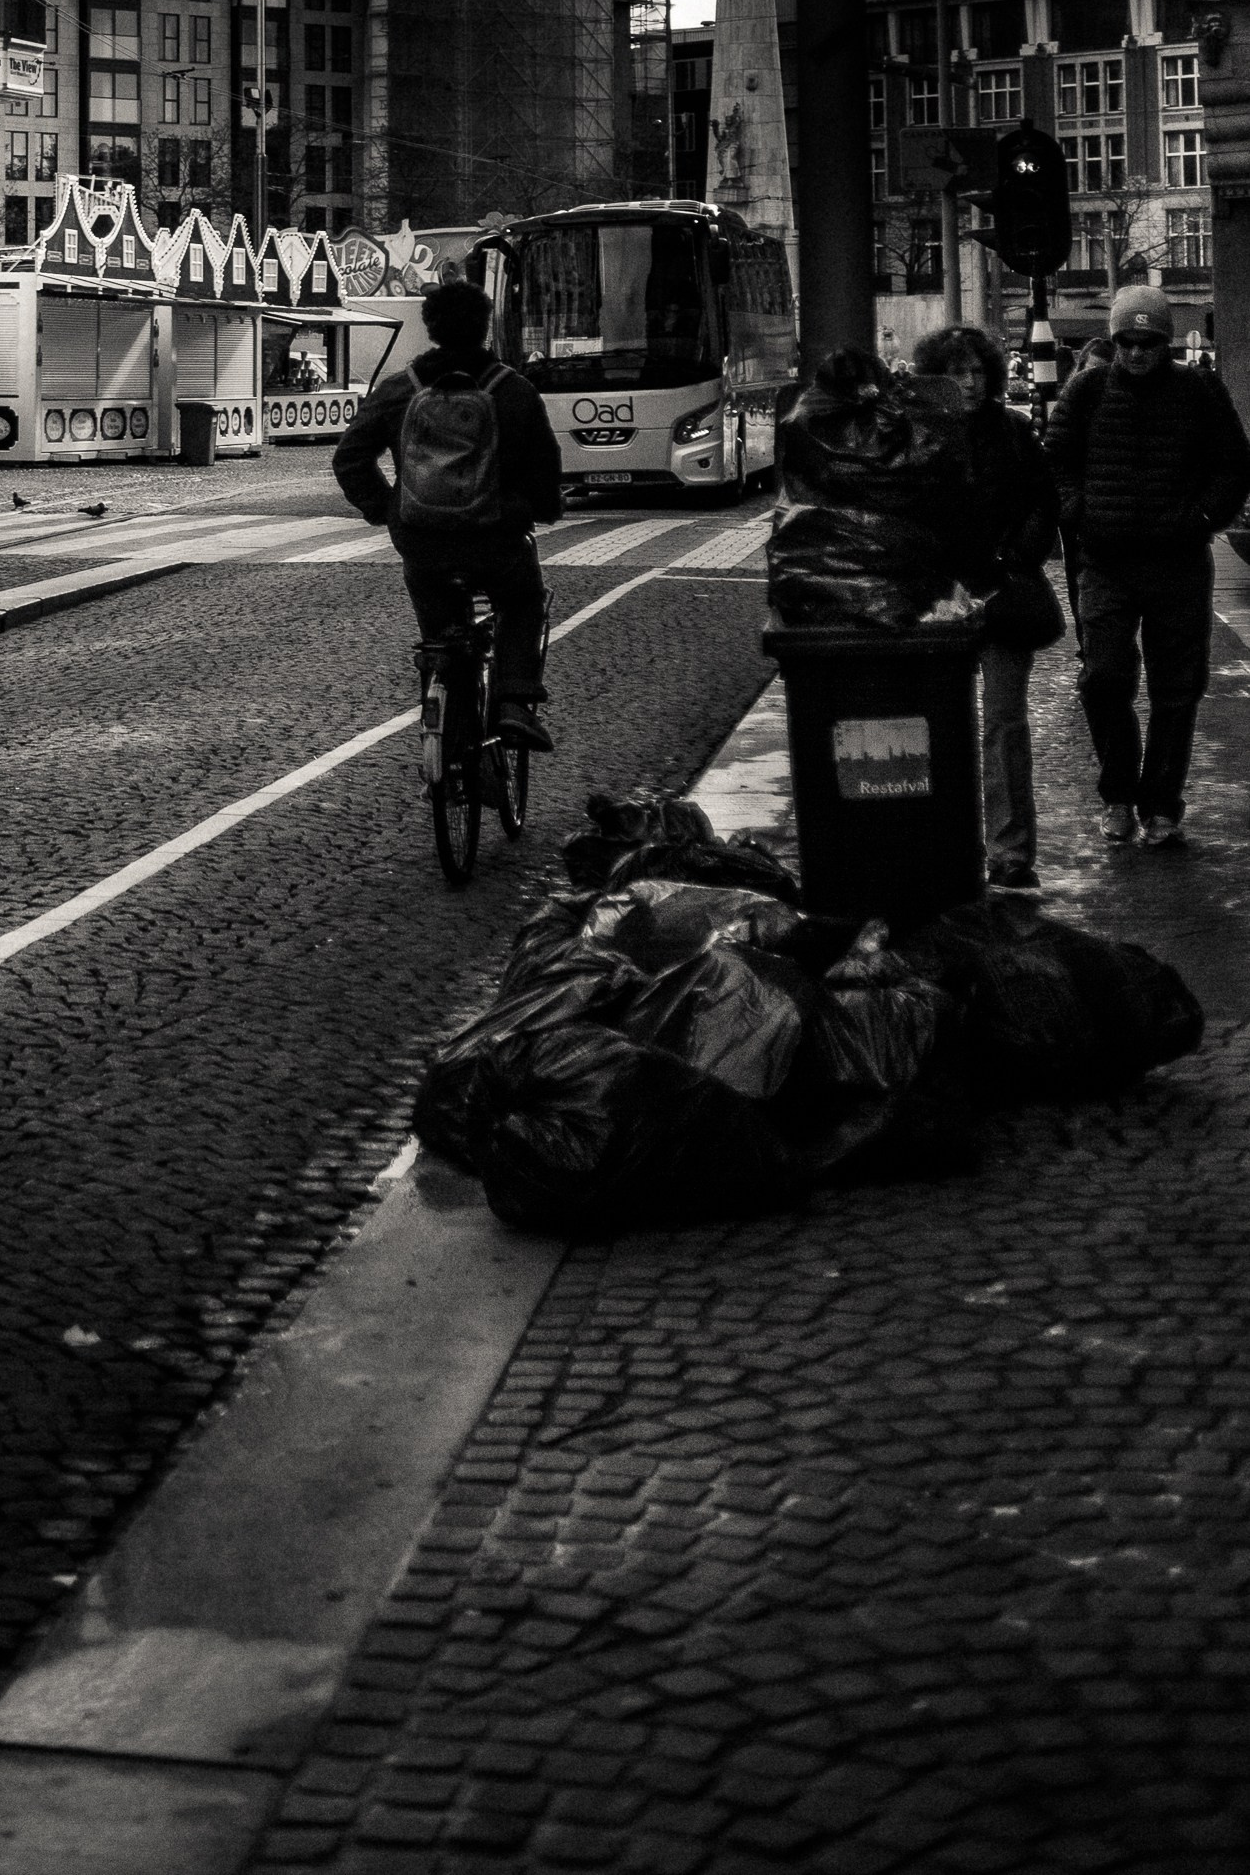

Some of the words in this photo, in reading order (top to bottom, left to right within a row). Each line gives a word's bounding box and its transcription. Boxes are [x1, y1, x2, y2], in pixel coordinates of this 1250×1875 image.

[10, 57, 21, 71] The
[21, 59, 37, 74] View
[338, 256, 381, 276] colate
[573, 396, 634, 424] Oad
[581, 430, 626, 442] VDL
[860, 776, 930, 794] Restafval
